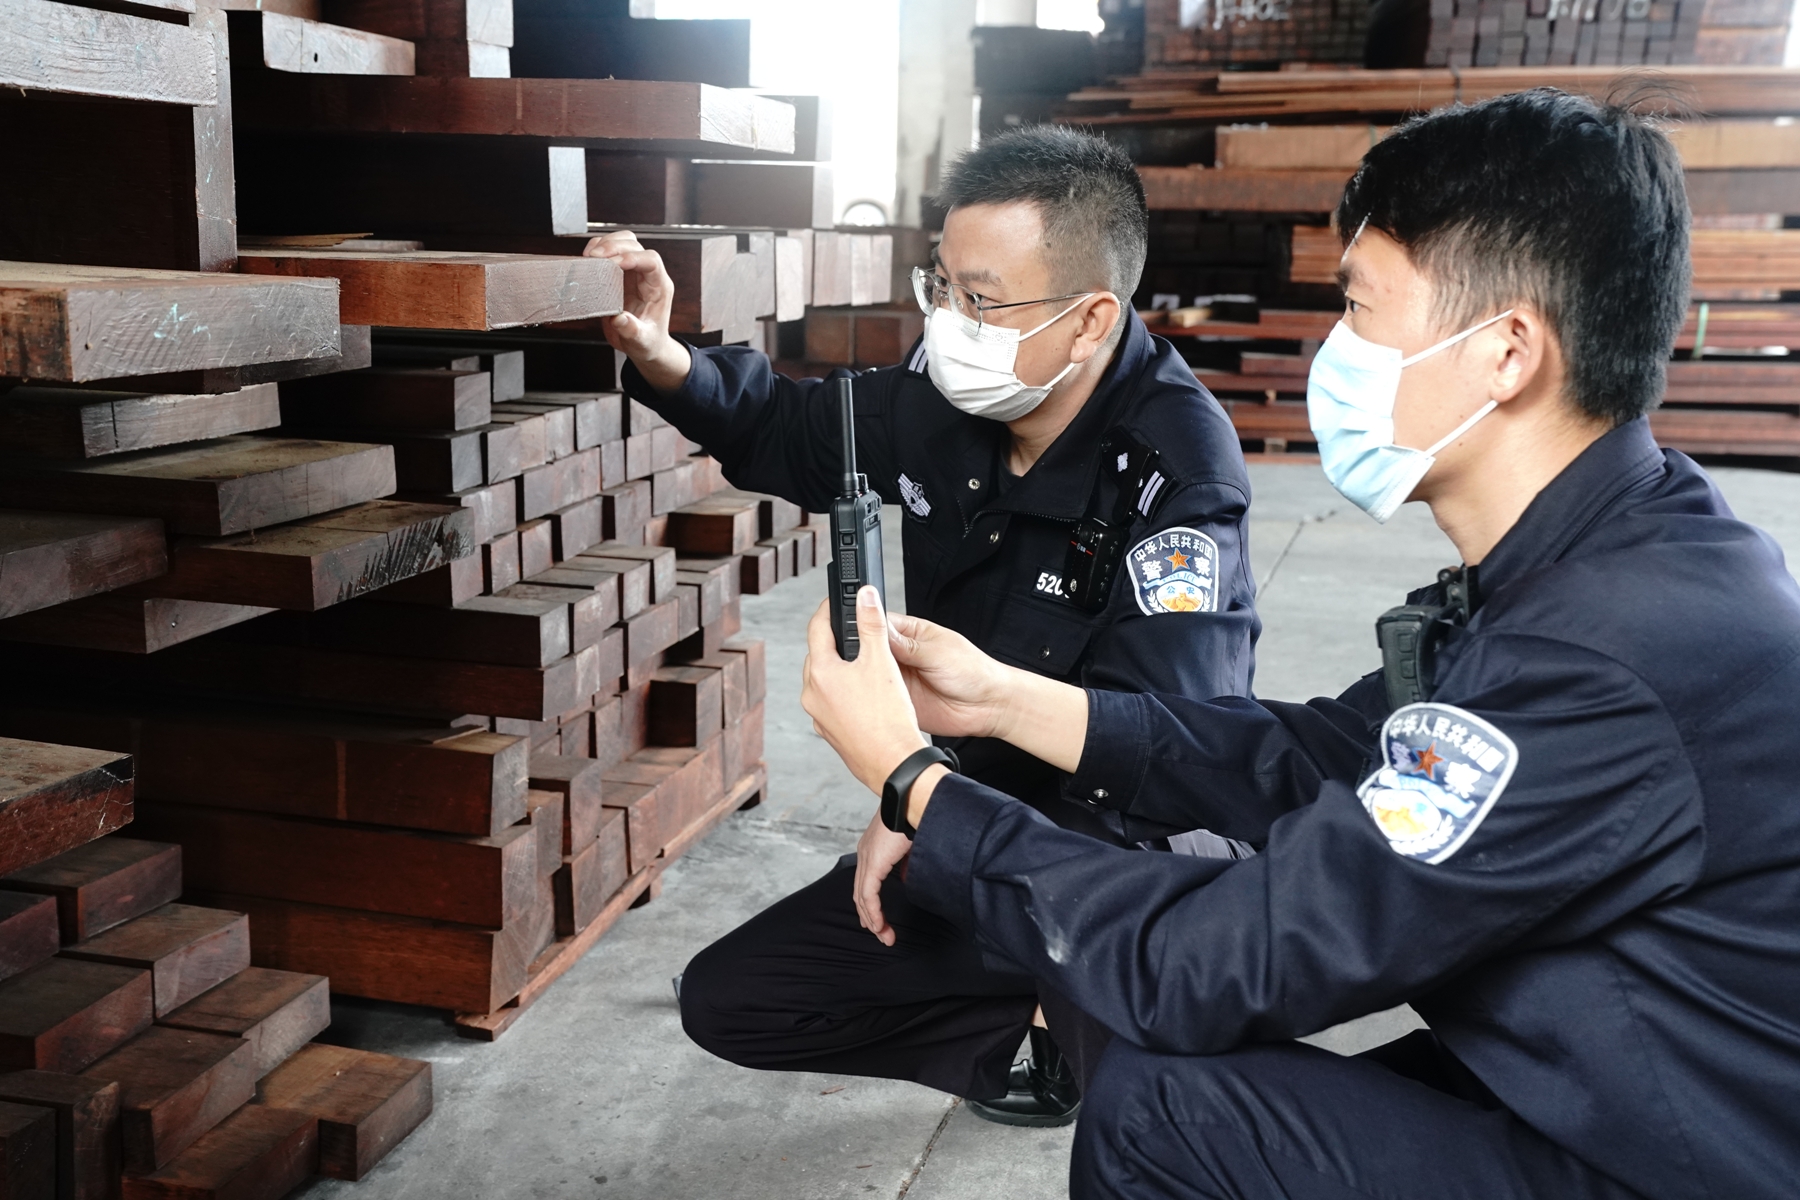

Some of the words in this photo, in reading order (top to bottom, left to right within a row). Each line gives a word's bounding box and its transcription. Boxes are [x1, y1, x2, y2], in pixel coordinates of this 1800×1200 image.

[1134, 534, 1213, 562] 中华人民共和国
[1389, 713, 1505, 773] 中华人民共和国
